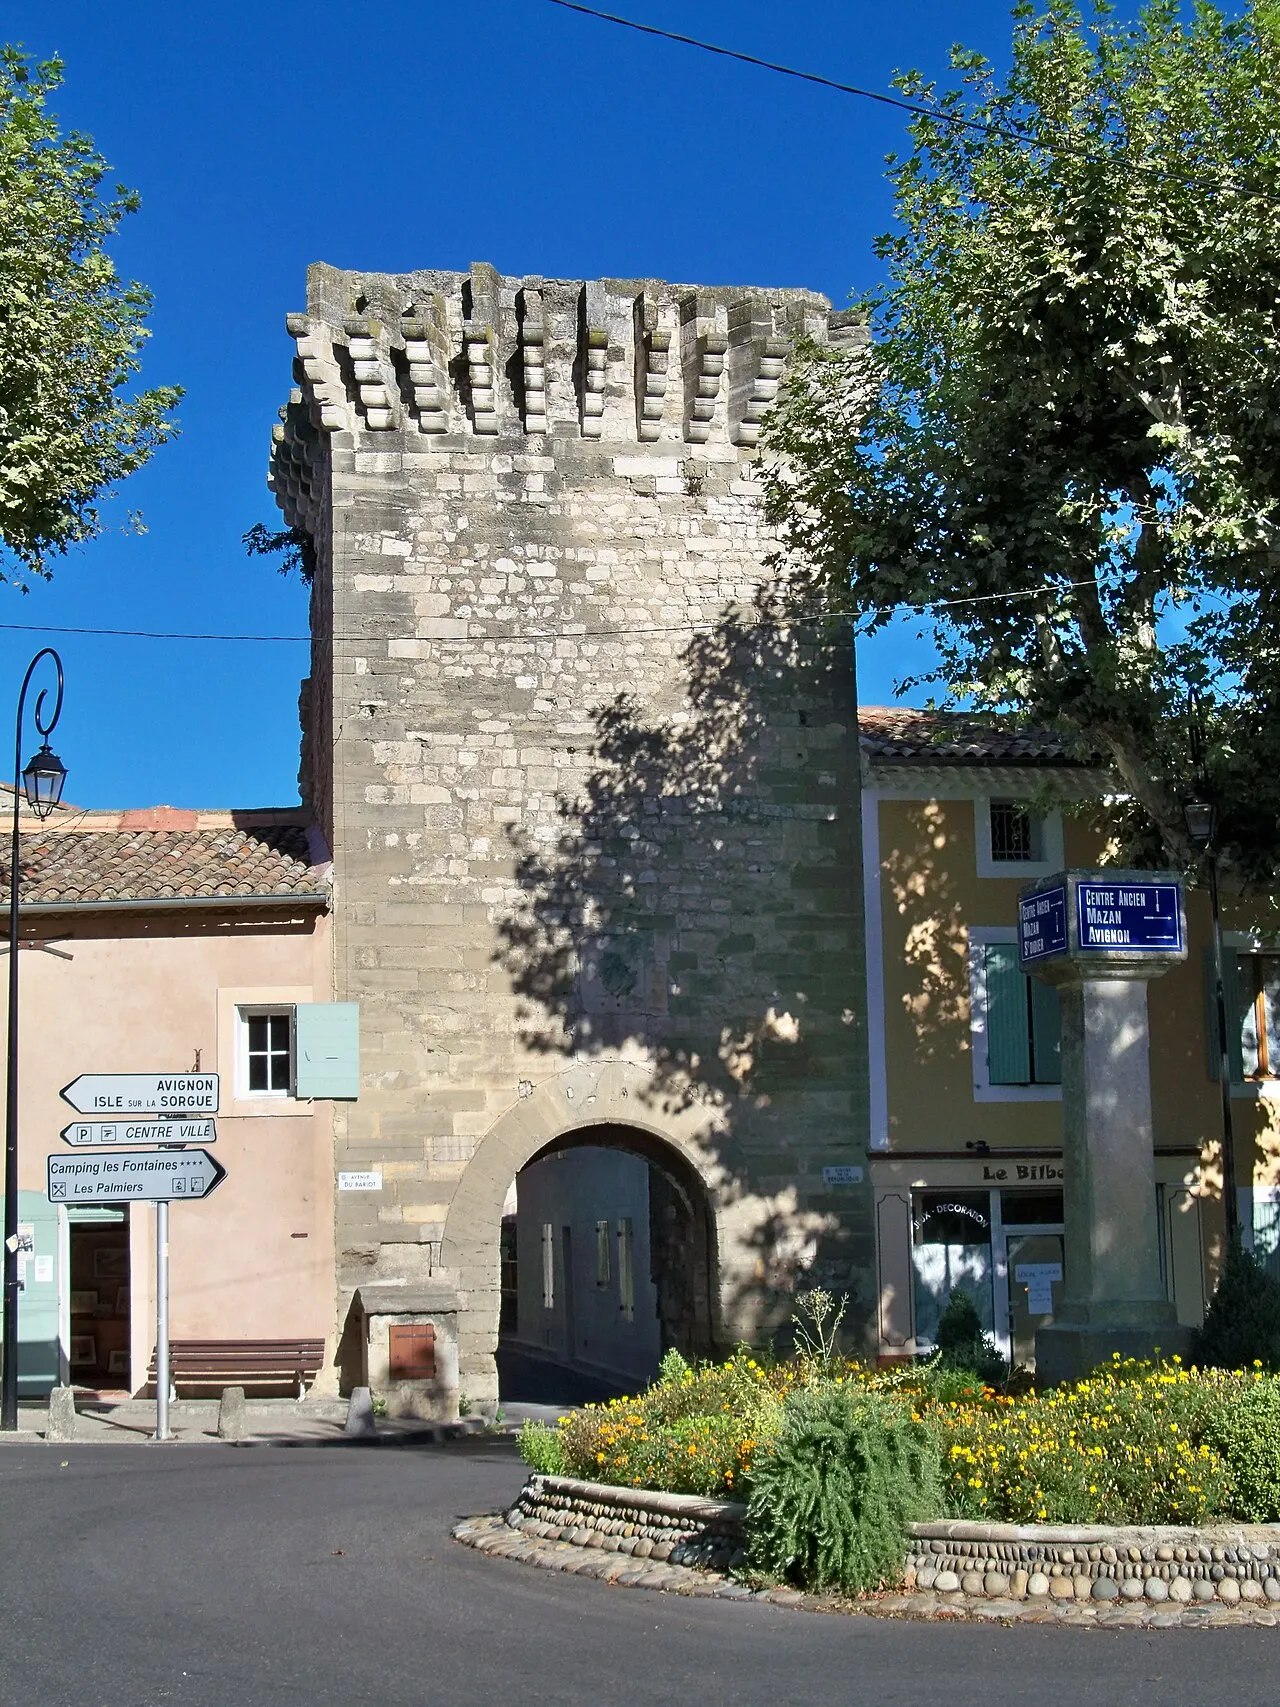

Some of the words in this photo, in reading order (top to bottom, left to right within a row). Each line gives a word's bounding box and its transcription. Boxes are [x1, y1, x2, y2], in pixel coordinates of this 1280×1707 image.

[1086, 889, 1114, 906] CENTRE
[1119, 890, 1146, 907] ANCIEN
[1086, 908, 1122, 925] MAZAN
[1088, 926, 1130, 943] AVIGNON
[157, 1080, 213, 1091] AVIGNON
[94, 1096, 123, 1107] ISLE
[128, 1099, 142, 1107] SUR
[146, 1099, 156, 1107] LA
[160, 1095, 213, 1107] SORGUE
[125, 1126, 173, 1139] CENTRE
[179, 1124, 211, 1137] VILLE
[50, 1162, 100, 1176] Camping
[103, 1160, 119, 1172] les
[122, 1159, 178, 1172] Fontaines
[983, 1166, 1008, 1181] Le
[74, 1183, 93, 1194] Les
[96, 1182, 144, 1193] Palmiers
